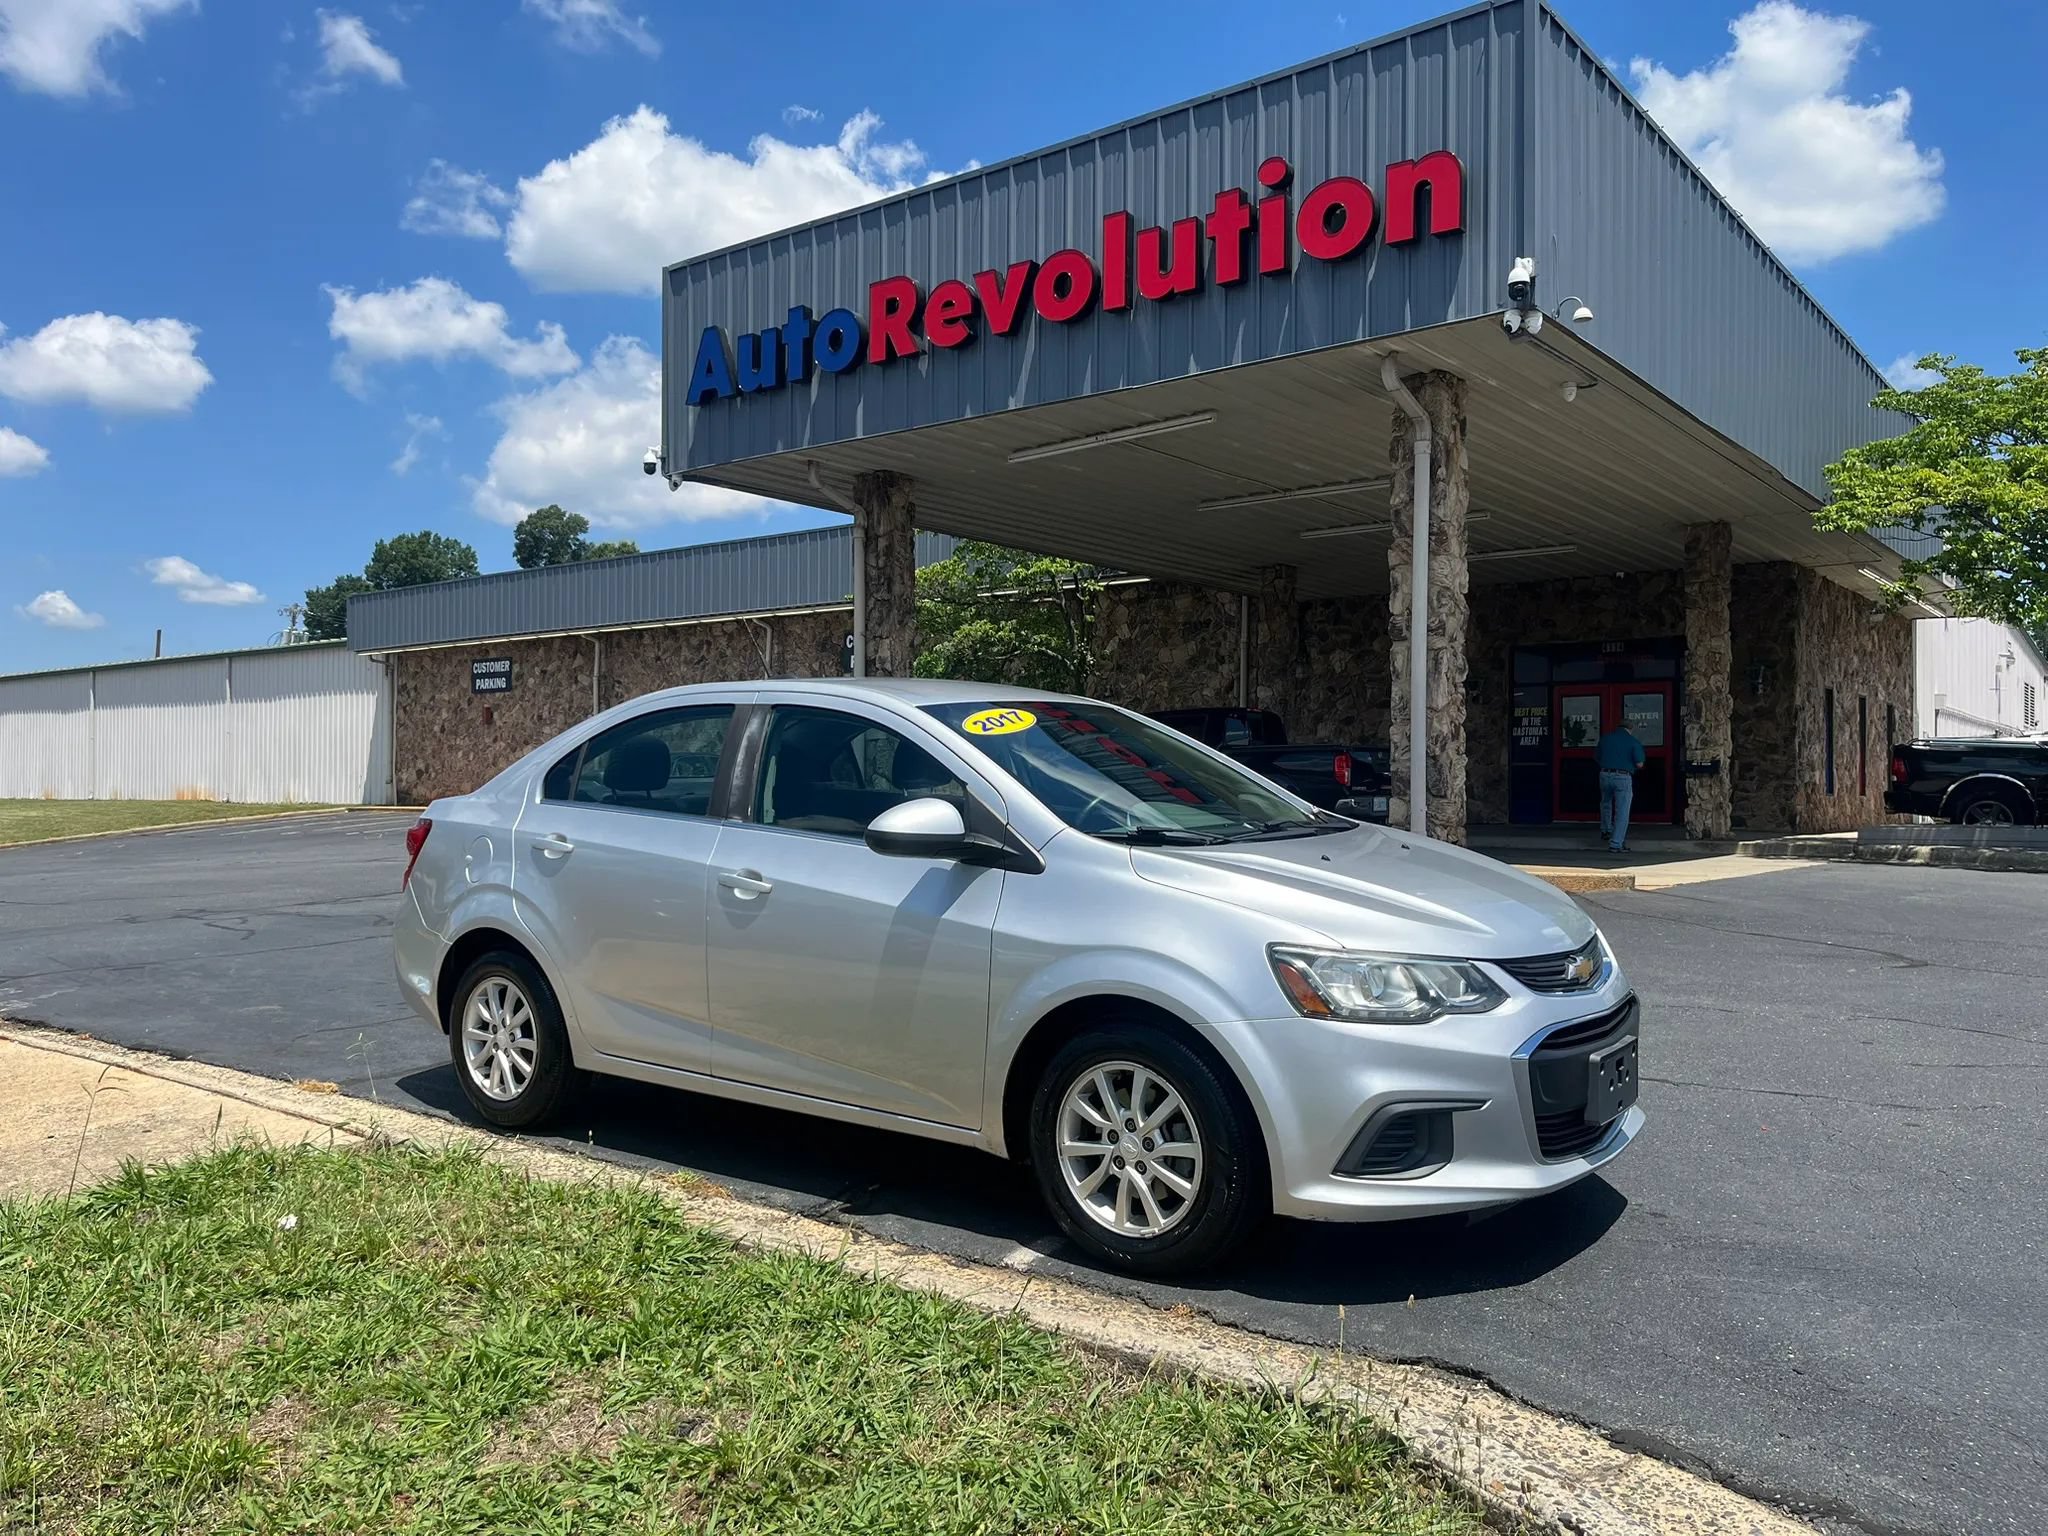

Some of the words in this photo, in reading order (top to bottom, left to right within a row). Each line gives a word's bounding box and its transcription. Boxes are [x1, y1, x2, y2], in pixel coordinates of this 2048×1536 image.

[473, 660, 510, 674] CUSTOMER
[475, 677, 506, 690] PARKING
[1514, 707, 1529, 717] BEST
[1530, 706, 1548, 717] PRICE
[1629, 712, 1659, 720] ENTER
[972, 711, 1024, 732] 2017
[1522, 717, 1529, 726] IN
[1530, 717, 1542, 726] THE
[1519, 736, 1539, 746] AREA!
